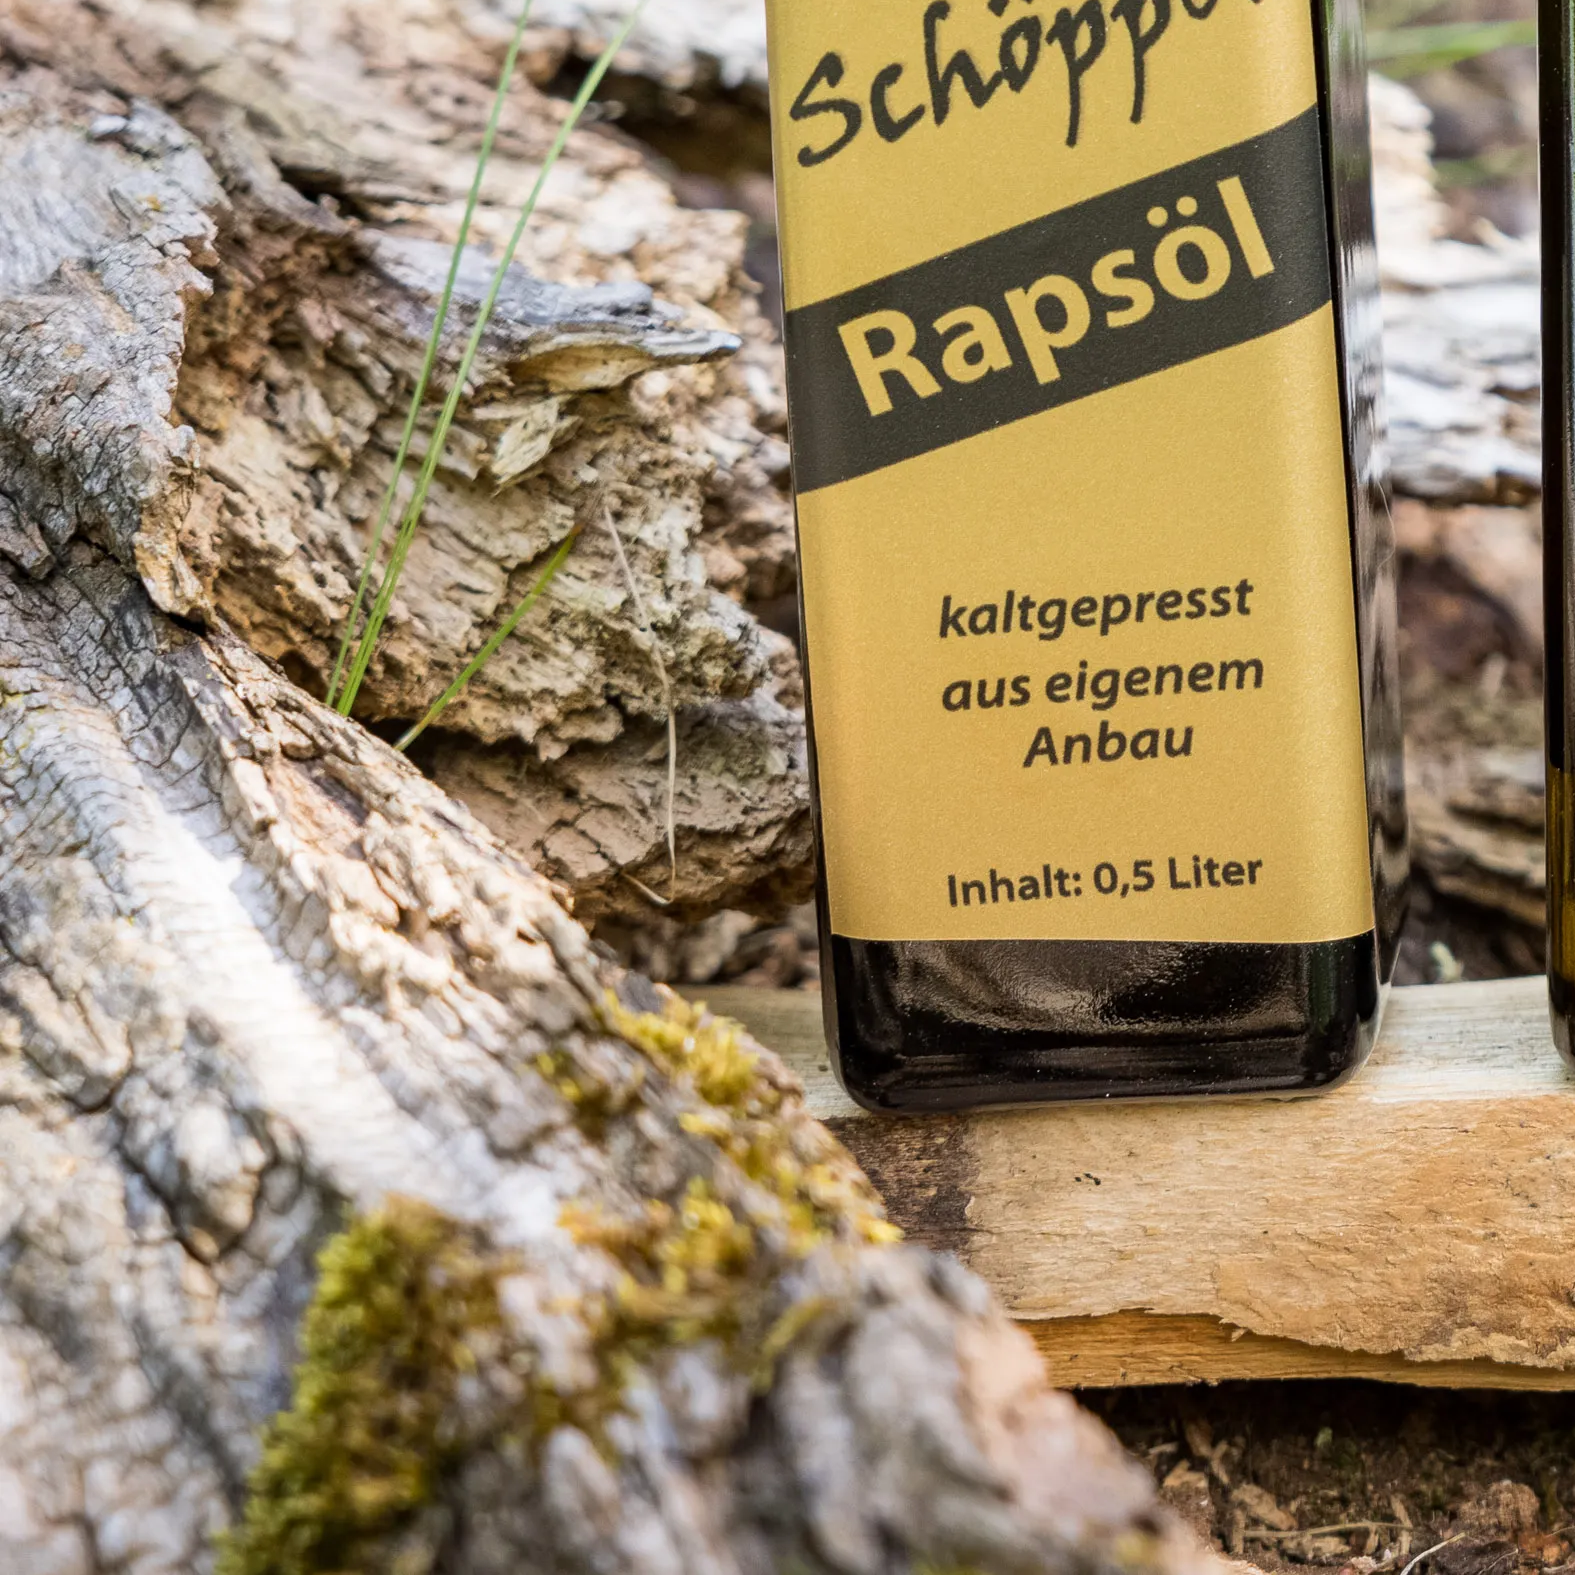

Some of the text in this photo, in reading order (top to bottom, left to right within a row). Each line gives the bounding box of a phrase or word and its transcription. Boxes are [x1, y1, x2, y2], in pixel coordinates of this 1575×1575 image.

[838, 176, 1274, 416] Rapsöl
[939, 579, 1253, 641] kaltgepresst
[942, 659, 1263, 711] aus eigenem
[1023, 720, 1193, 767] Anbau
[948, 855, 1262, 907] Inhalt: 0,5 Liter
